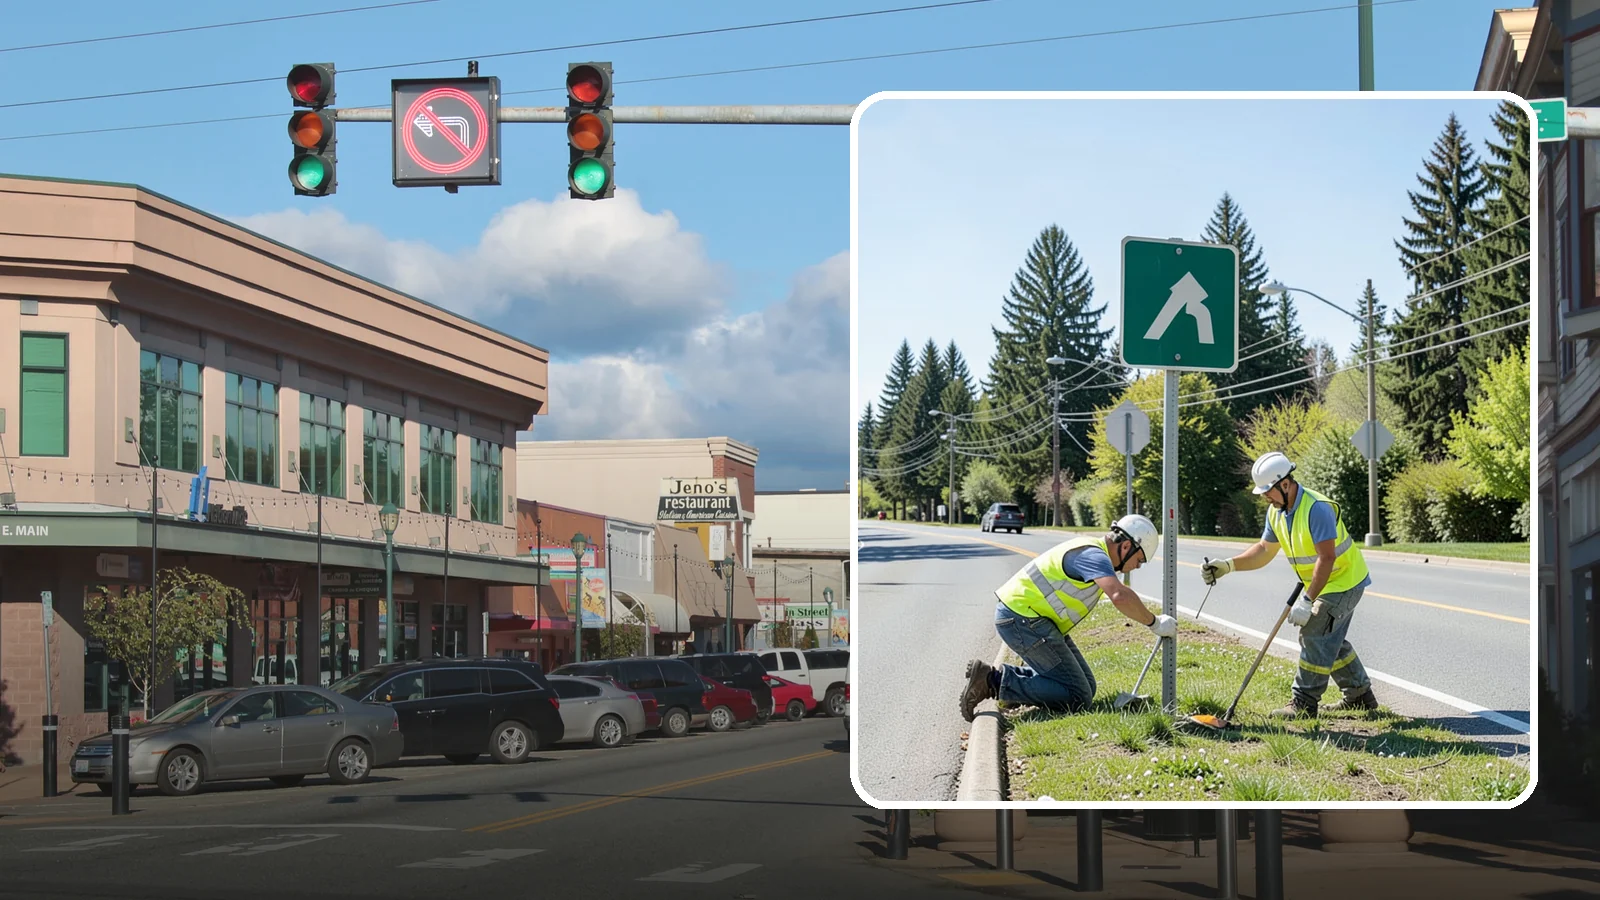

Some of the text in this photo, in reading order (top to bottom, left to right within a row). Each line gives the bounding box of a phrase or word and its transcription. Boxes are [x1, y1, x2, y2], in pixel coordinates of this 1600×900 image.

[670, 480, 727, 494] Jeno's
[665, 496, 731, 508] restaurant
[686, 510, 714, 519] American
[715, 510, 737, 519] Cuisine
[2, 525, 49, 536] E. MAIN
[797, 607, 828, 616] Street
